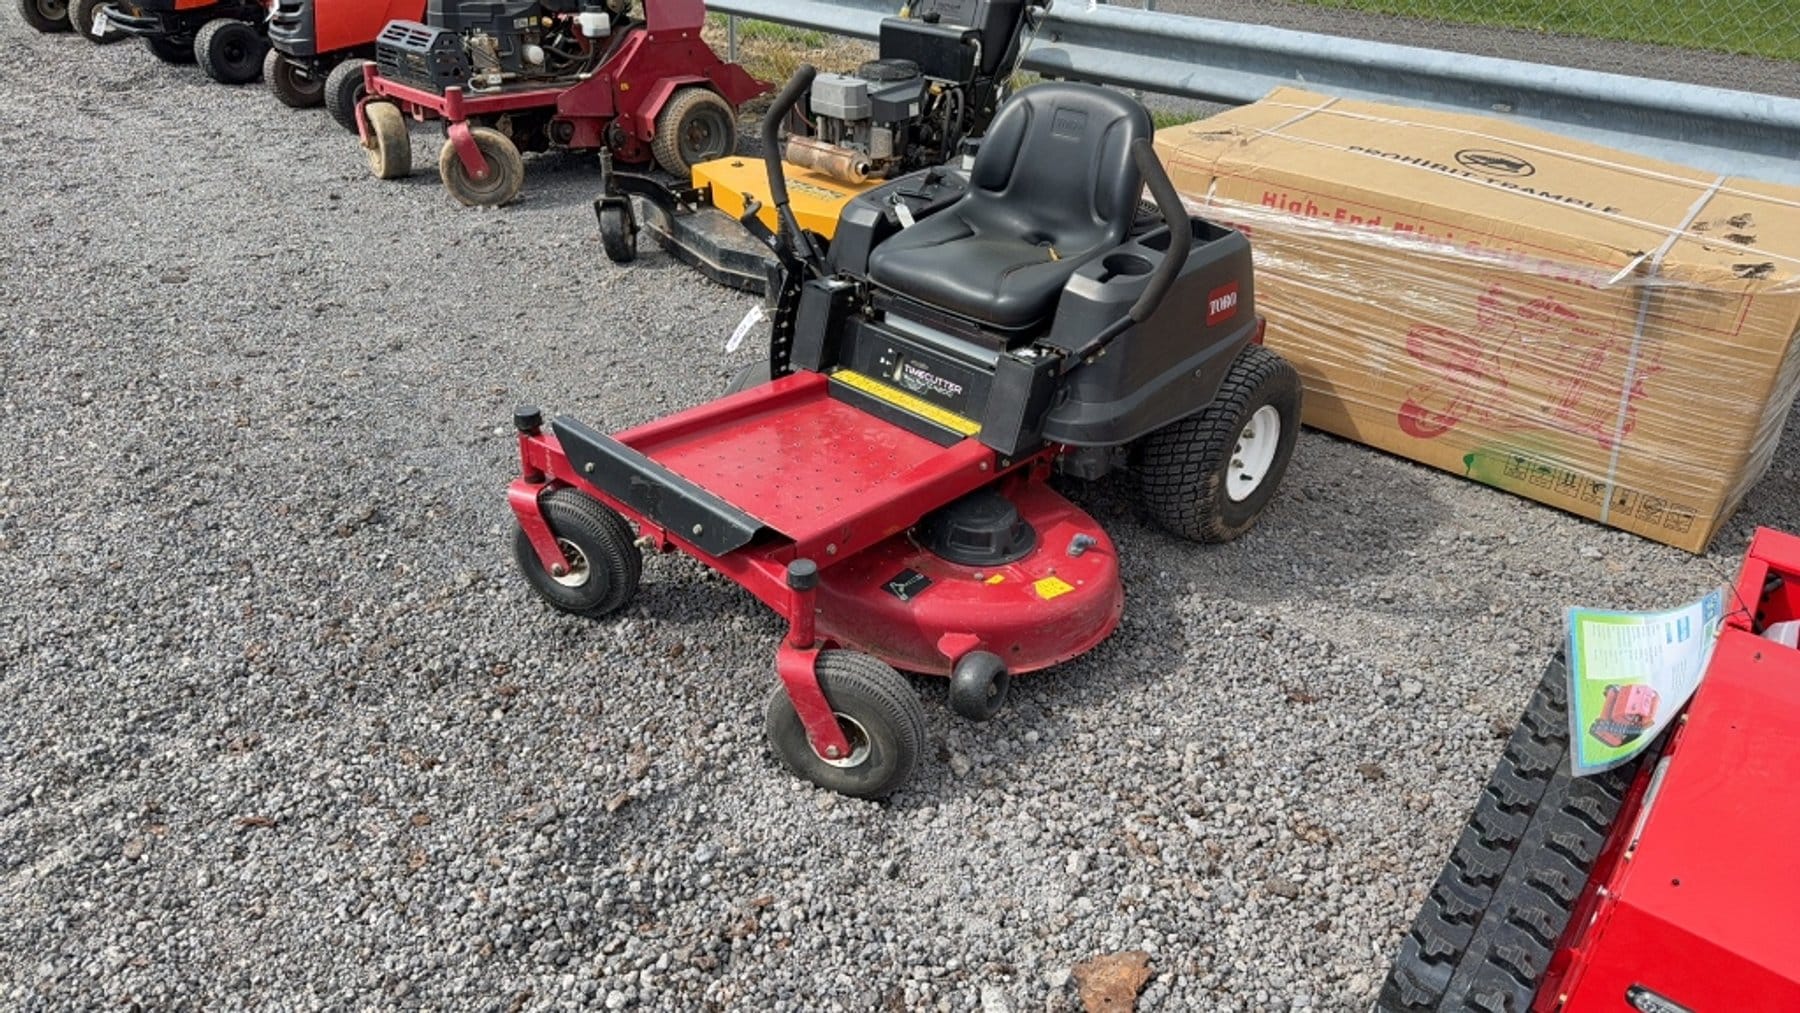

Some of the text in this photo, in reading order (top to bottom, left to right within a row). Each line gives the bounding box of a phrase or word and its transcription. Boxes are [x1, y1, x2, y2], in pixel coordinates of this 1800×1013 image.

[1348, 145, 1622, 213] PROHIBIT TRAMPLE
[1261, 190, 1381, 227] High-End
[1208, 291, 1238, 316] TORO
[903, 363, 963, 395] TIMECUTTER
